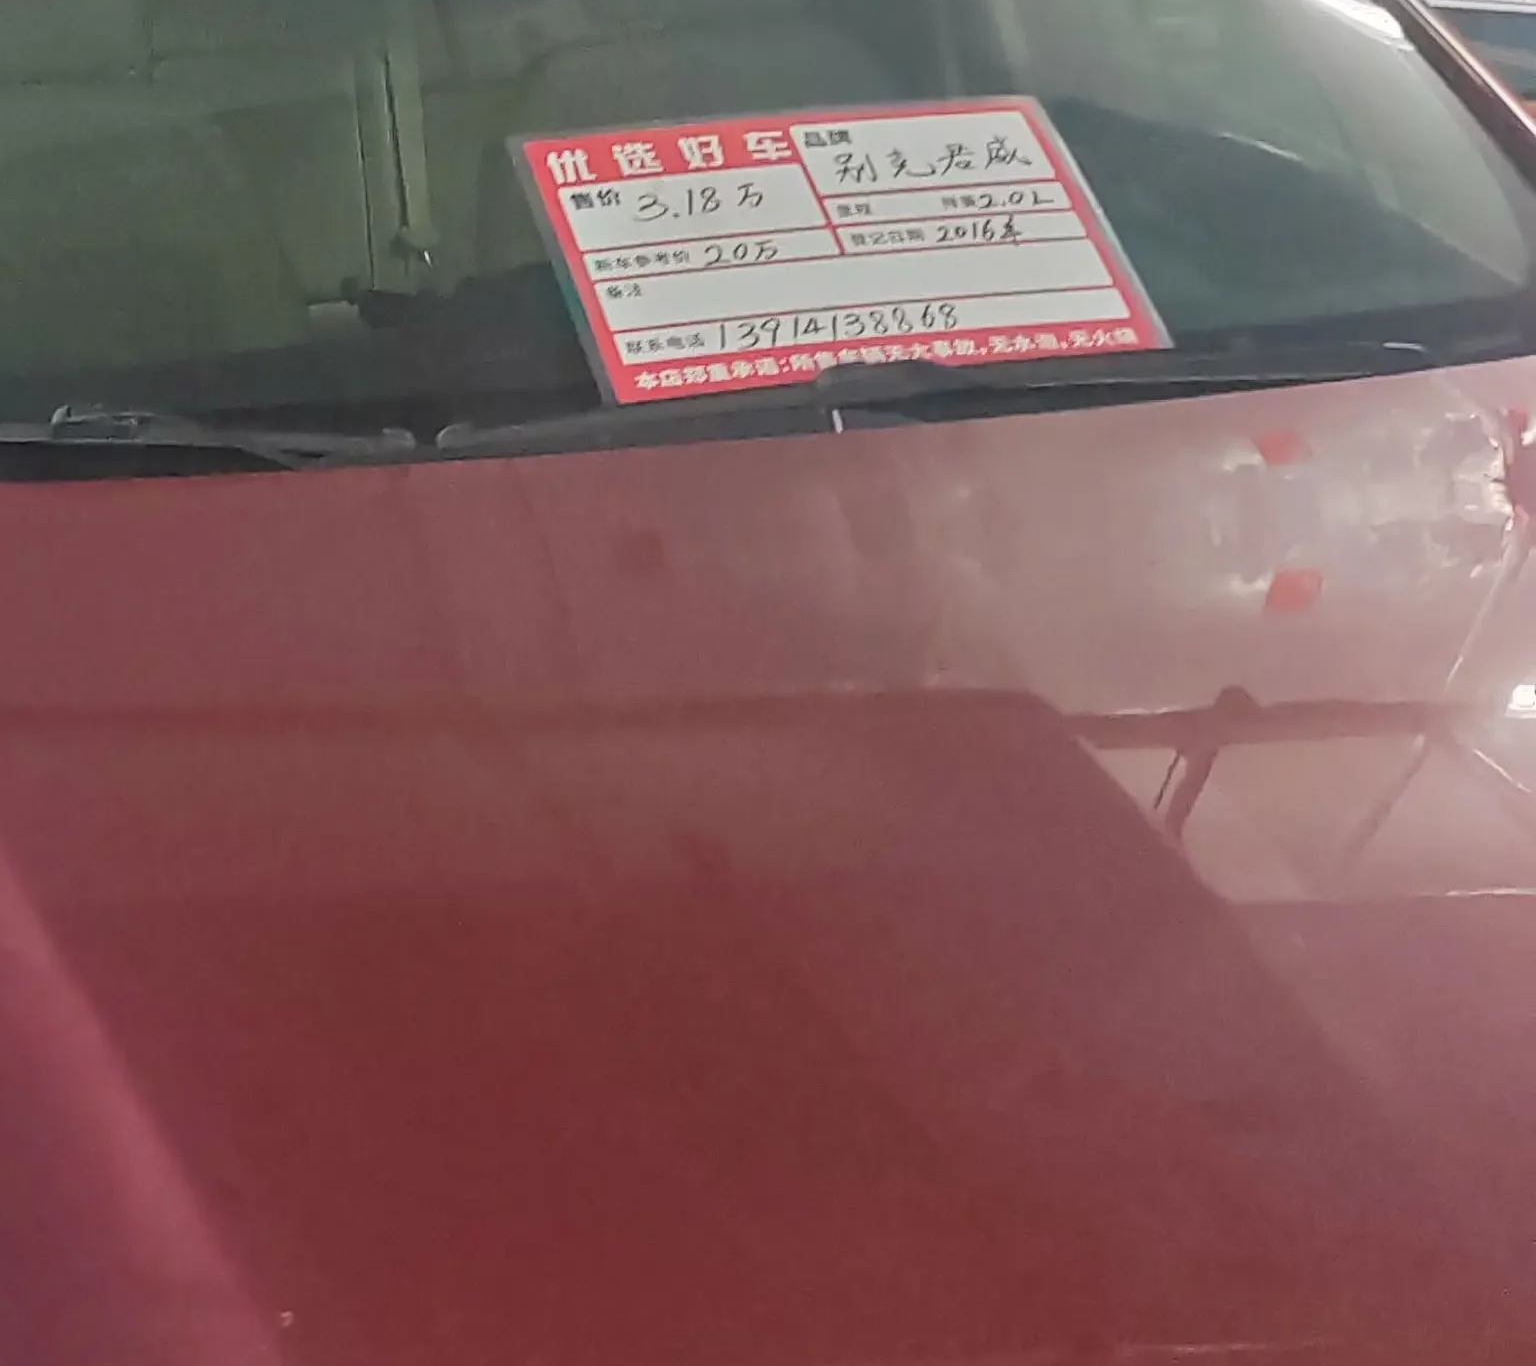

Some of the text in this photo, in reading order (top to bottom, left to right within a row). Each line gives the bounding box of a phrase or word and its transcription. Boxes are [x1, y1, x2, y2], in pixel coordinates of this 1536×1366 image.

[545, 129, 793, 185] 优选好车
[569, 187, 621, 210] 售价
[718, 302, 958, 351] 13914138868
